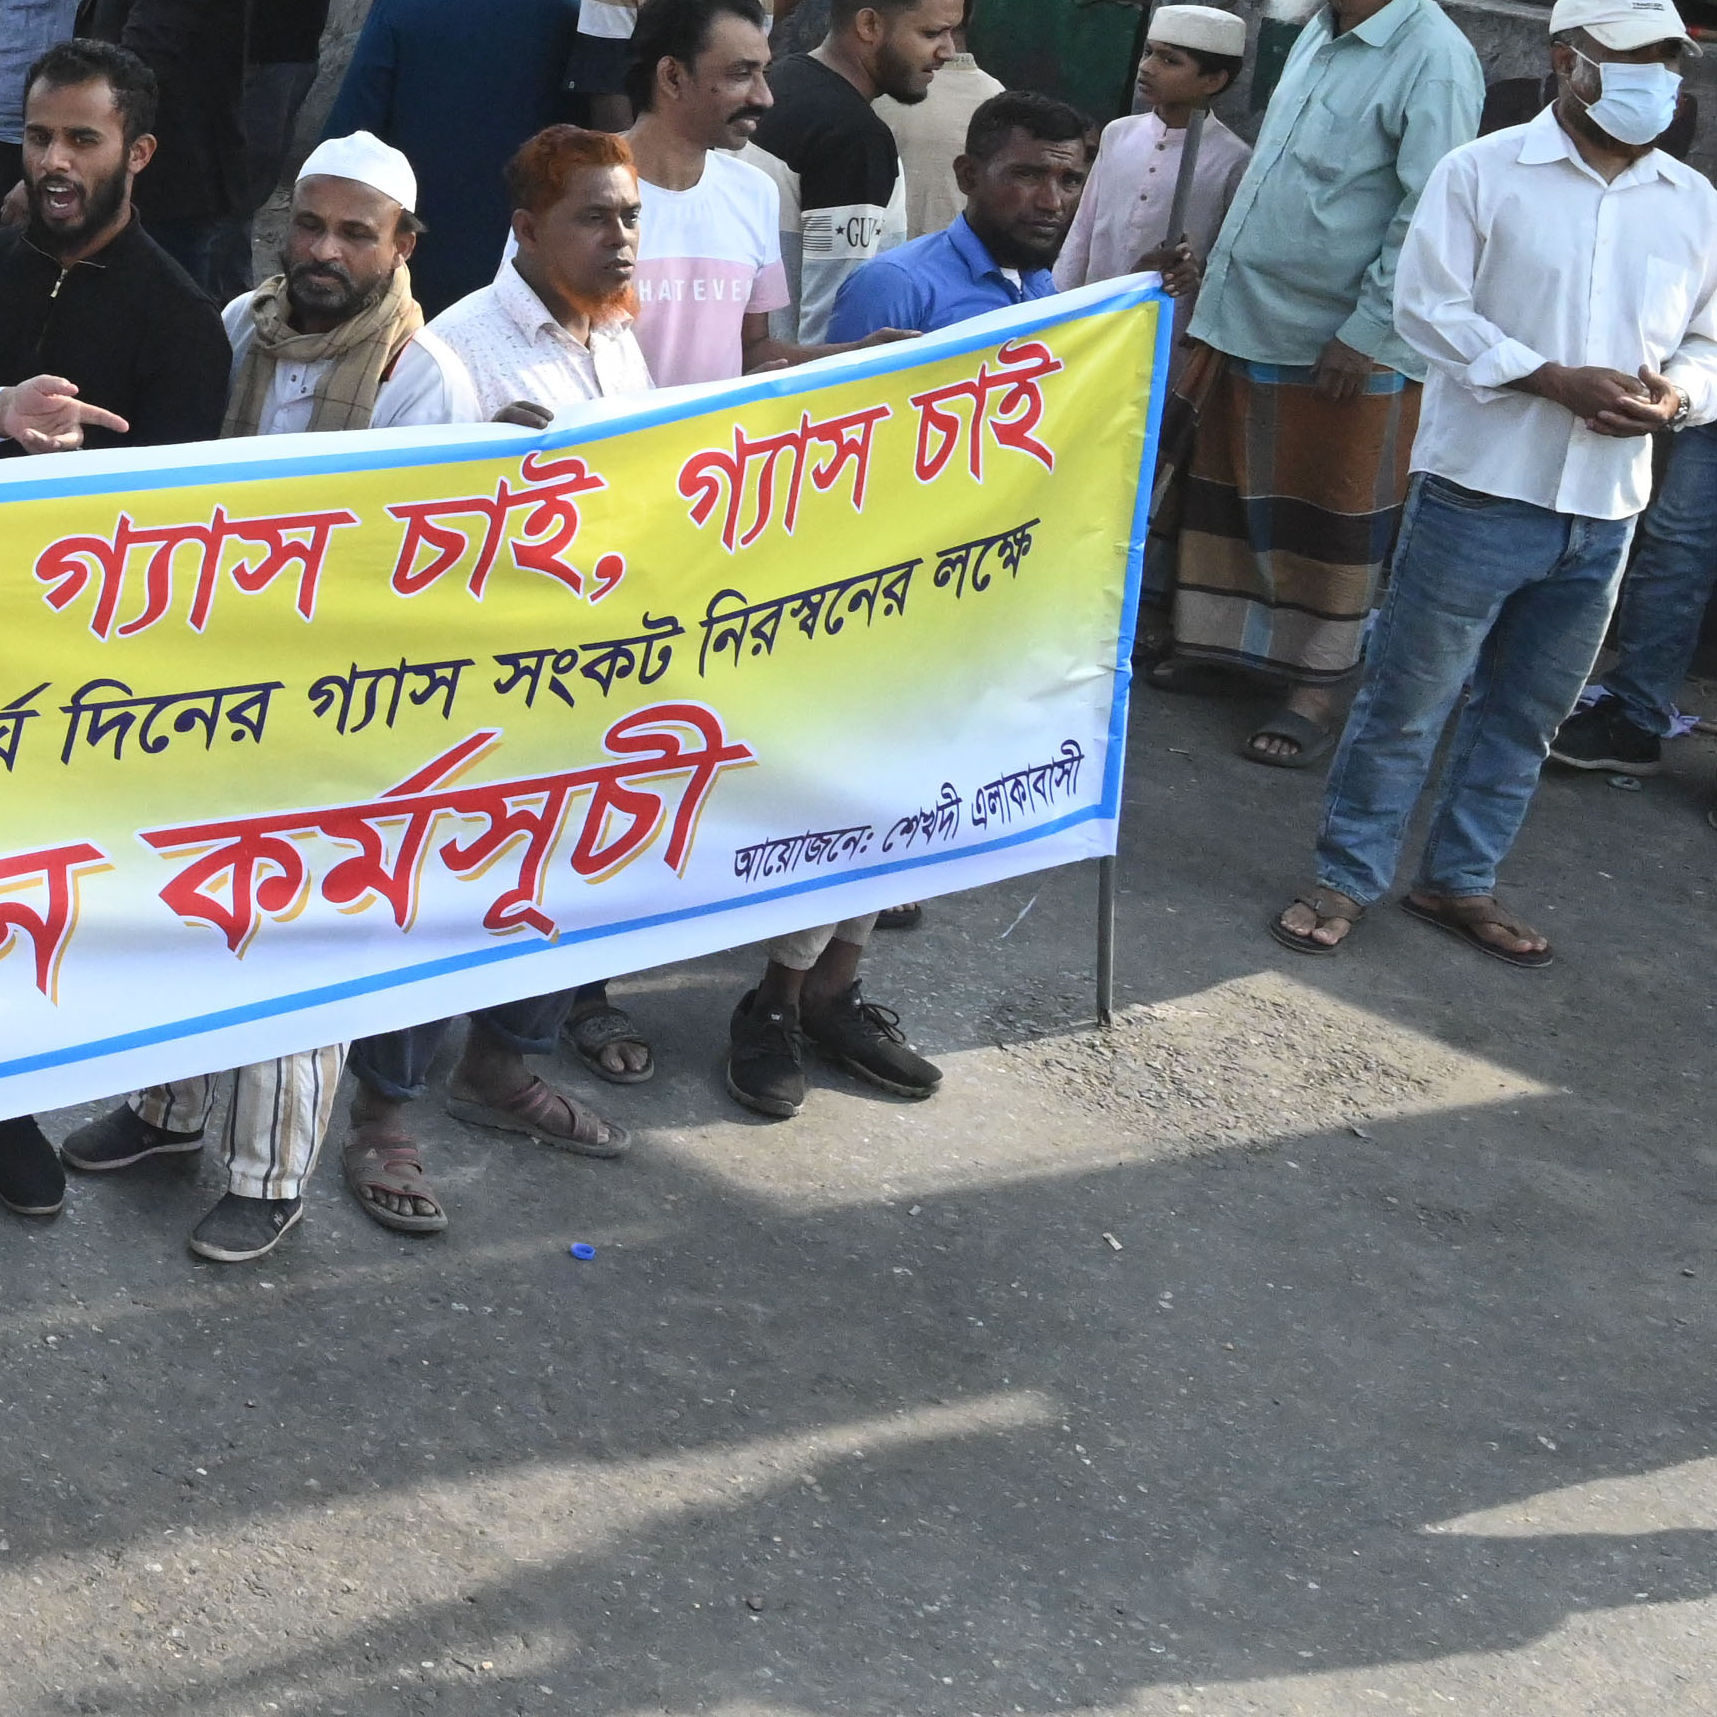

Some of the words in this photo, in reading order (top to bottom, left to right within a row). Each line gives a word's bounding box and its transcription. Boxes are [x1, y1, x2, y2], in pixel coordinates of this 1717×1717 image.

[36, 503, 361, 644] গ্যাস
[384, 449, 626, 604] চাই,
[675, 403, 893, 553] গ্যাস
[908, 337, 1065, 484] চাই
[61, 676, 283, 767] দিনের
[309, 658, 475, 736] গ্যাস
[494, 614, 684, 709] সংকট
[141, 700, 757, 960] কর্মসূচী
[883, 784, 961, 857] শেখদী
[970, 739, 1084, 827] এলাকাবাসী
